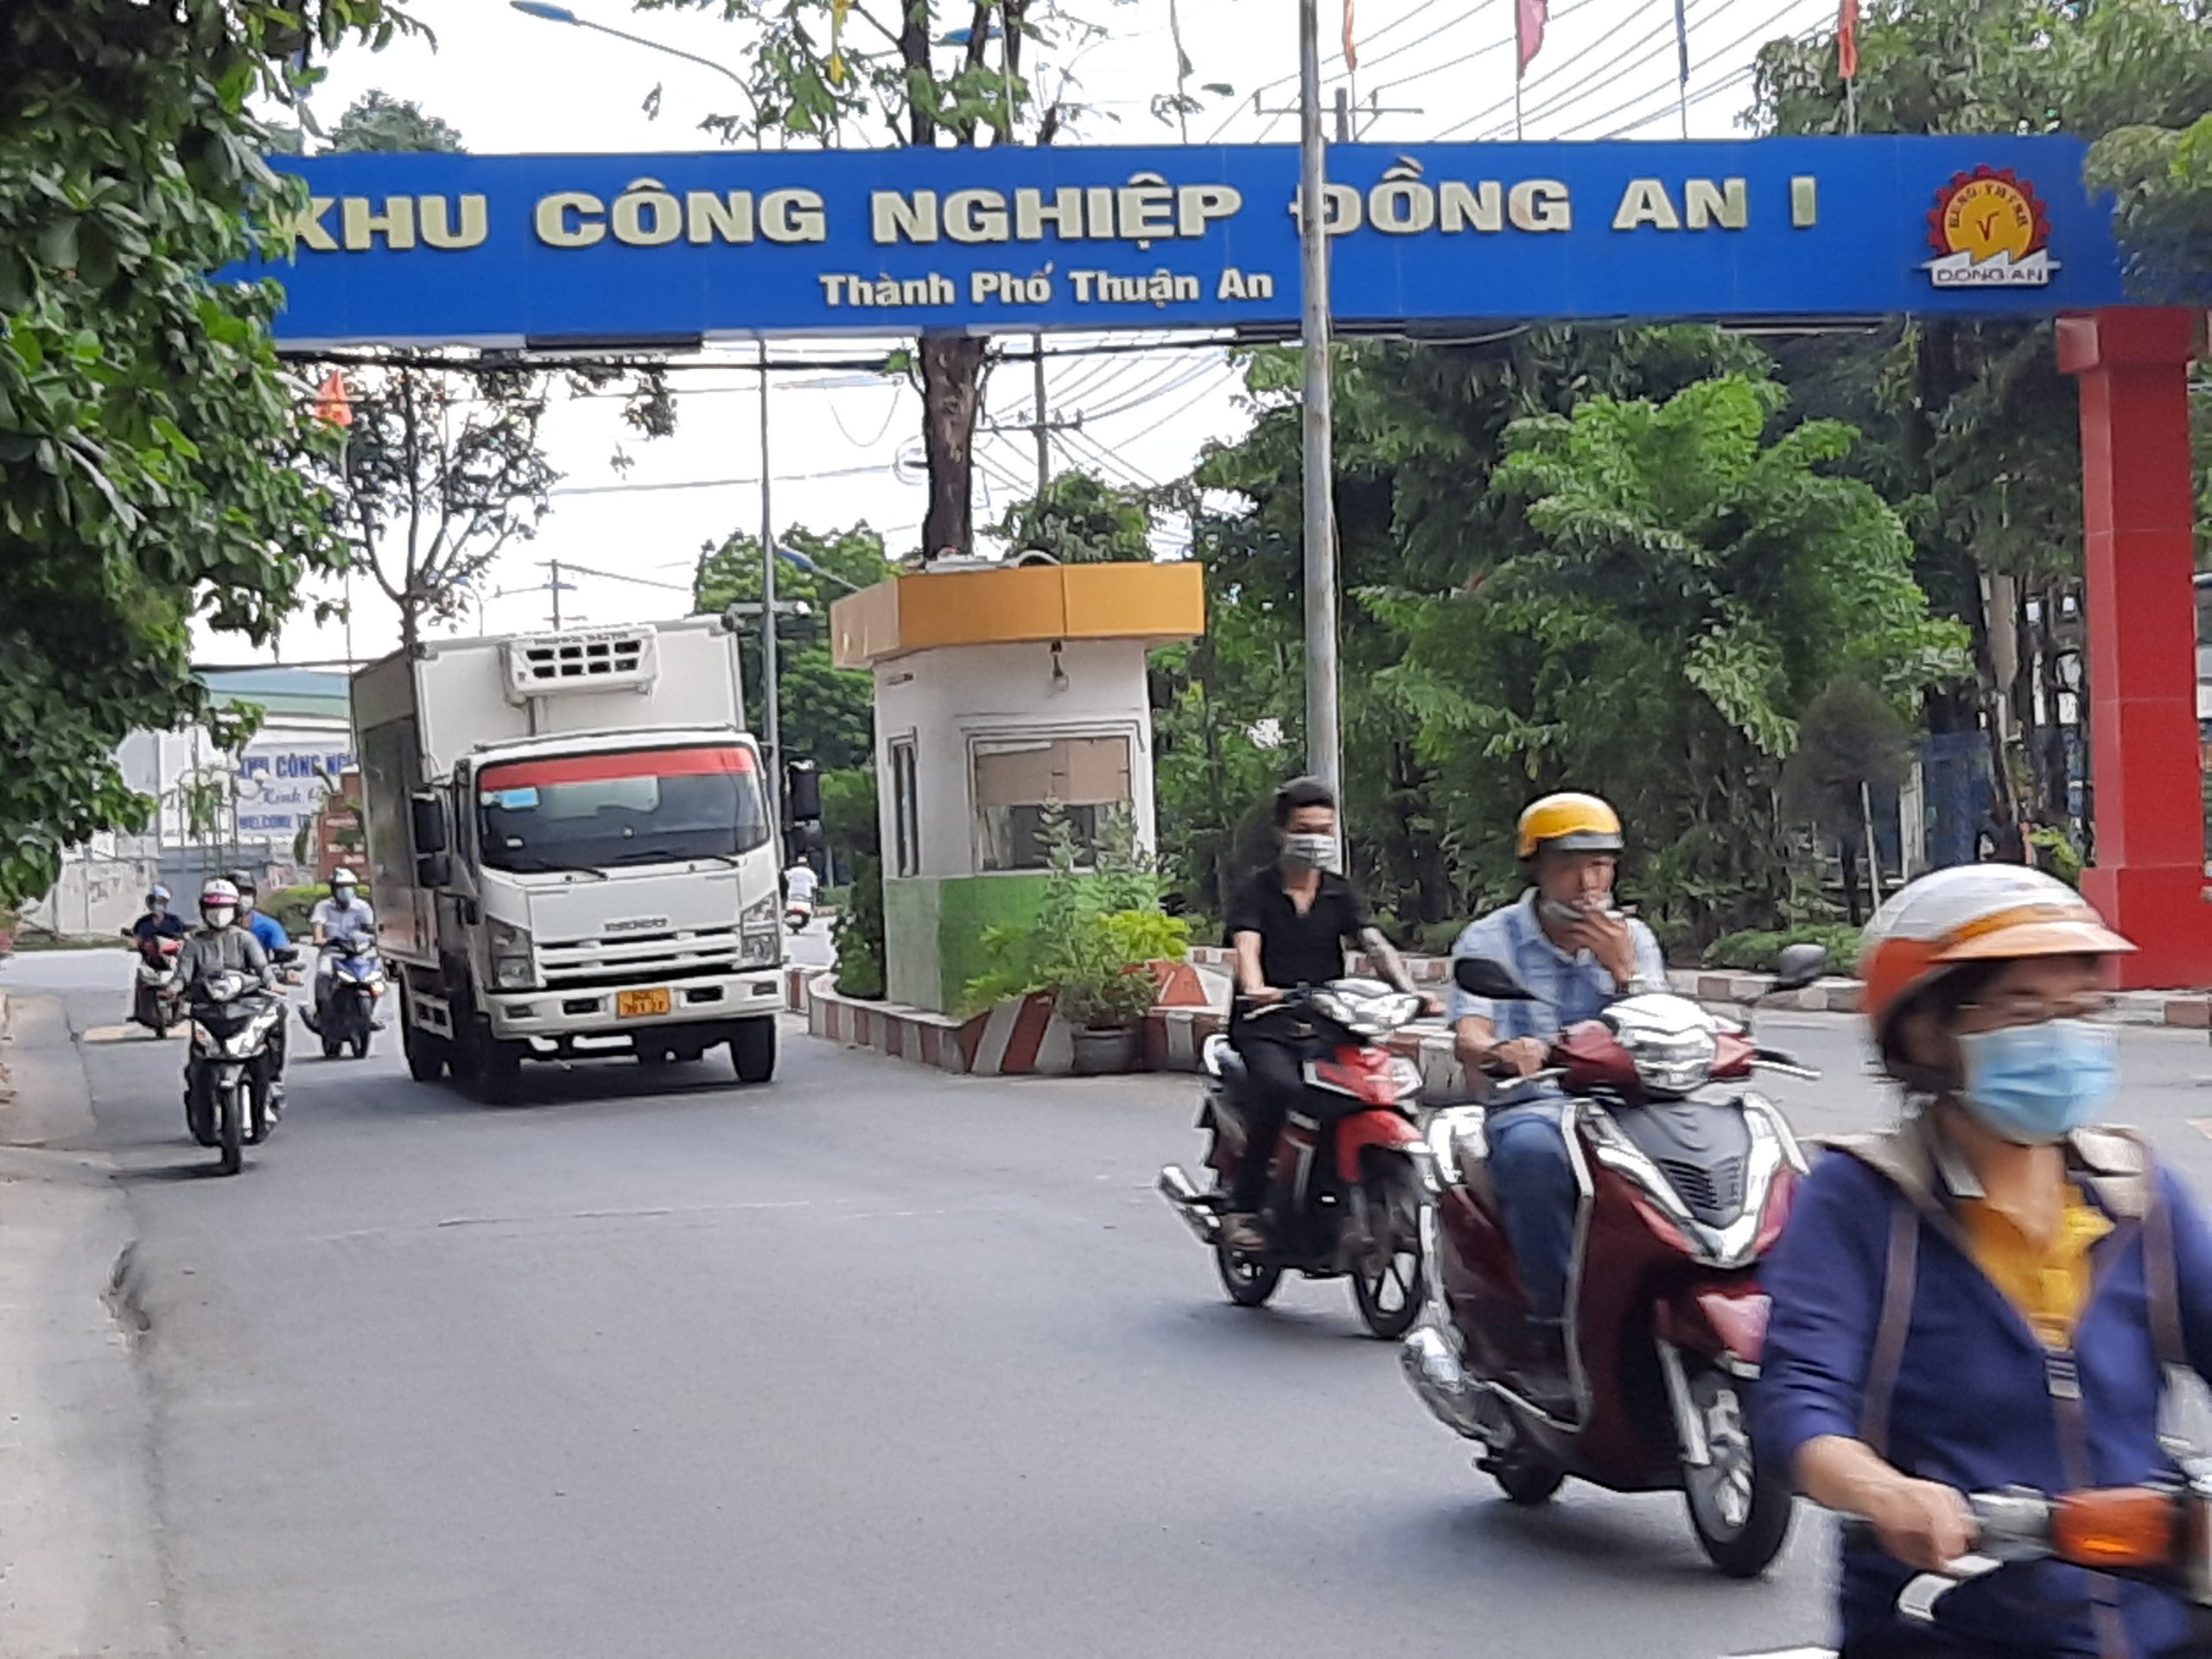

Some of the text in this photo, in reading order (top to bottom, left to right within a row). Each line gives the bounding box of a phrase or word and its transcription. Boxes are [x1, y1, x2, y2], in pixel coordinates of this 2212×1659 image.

[269, 155, 1817, 251] KHU CÔNG NGHIỆP ĐỒNG AN I
[819, 259, 1274, 308] Thành Phố Thuận An
